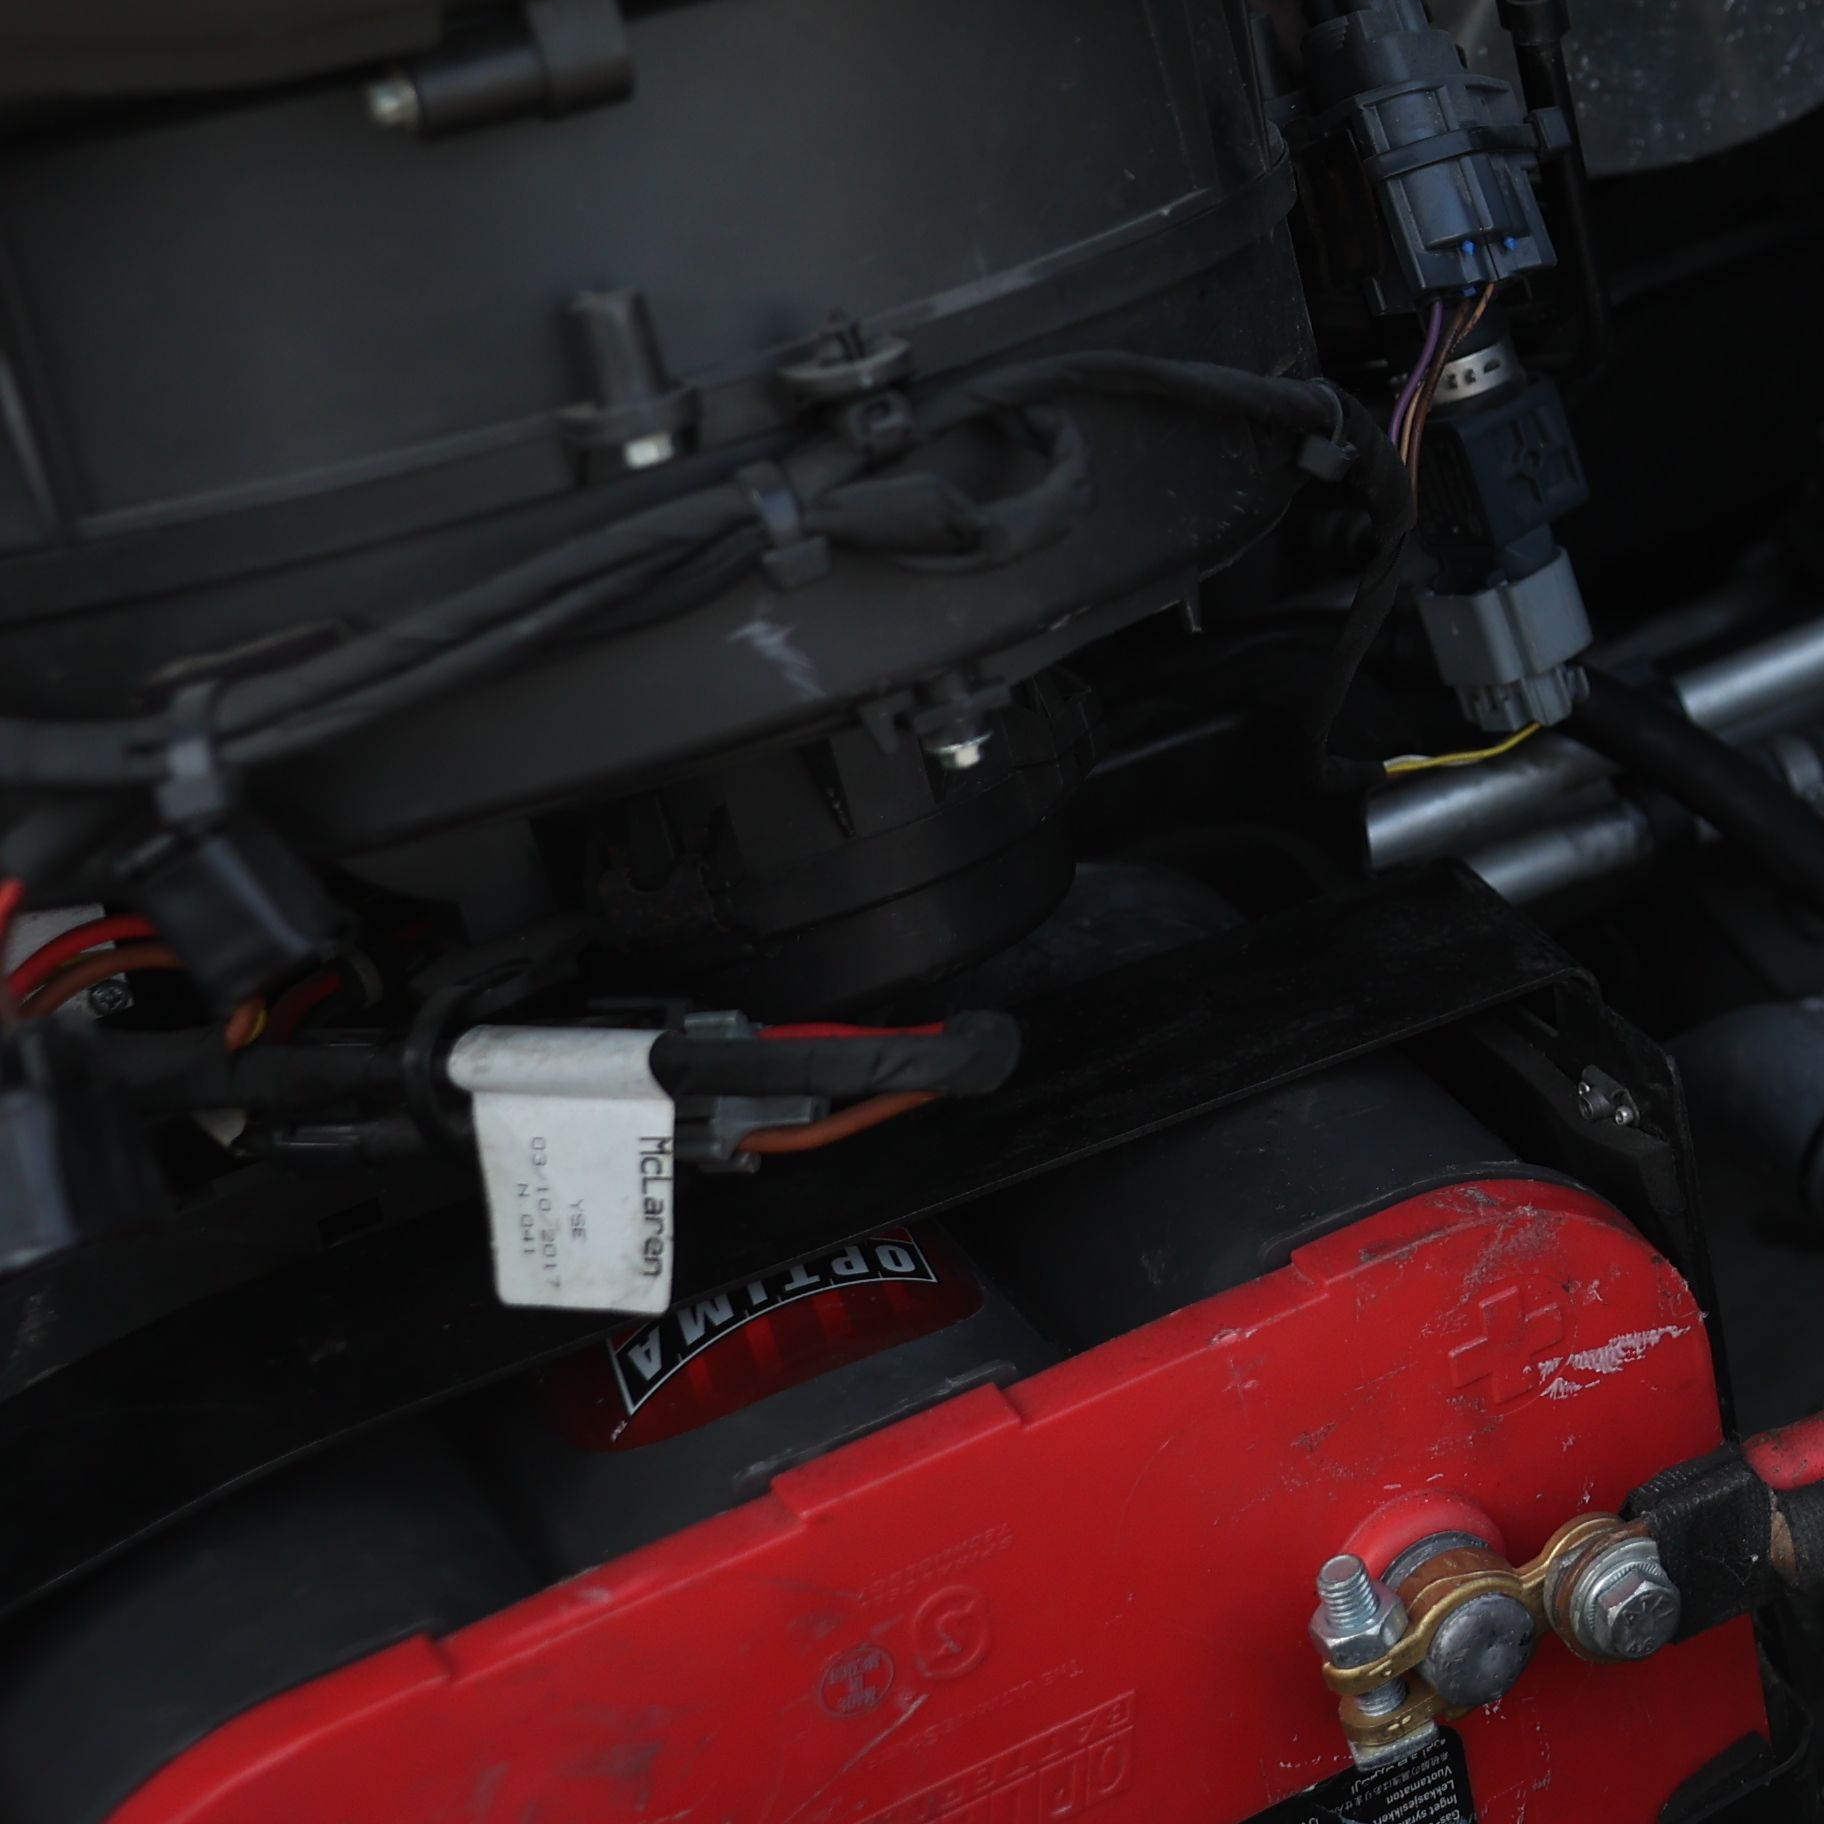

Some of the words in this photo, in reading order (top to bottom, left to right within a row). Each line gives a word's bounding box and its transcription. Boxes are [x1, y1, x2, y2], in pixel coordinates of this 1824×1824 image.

[531, 1135, 561, 1289] 03/10/2017
[569, 1199, 586, 1242] YSE
[638, 1135, 673, 1278] McLaren
[626, 1242, 918, 1383] OPTIMA
[1386, 1764, 1453, 1804] Vuotamaton
[1429, 1793, 1459, 1818] Inget
